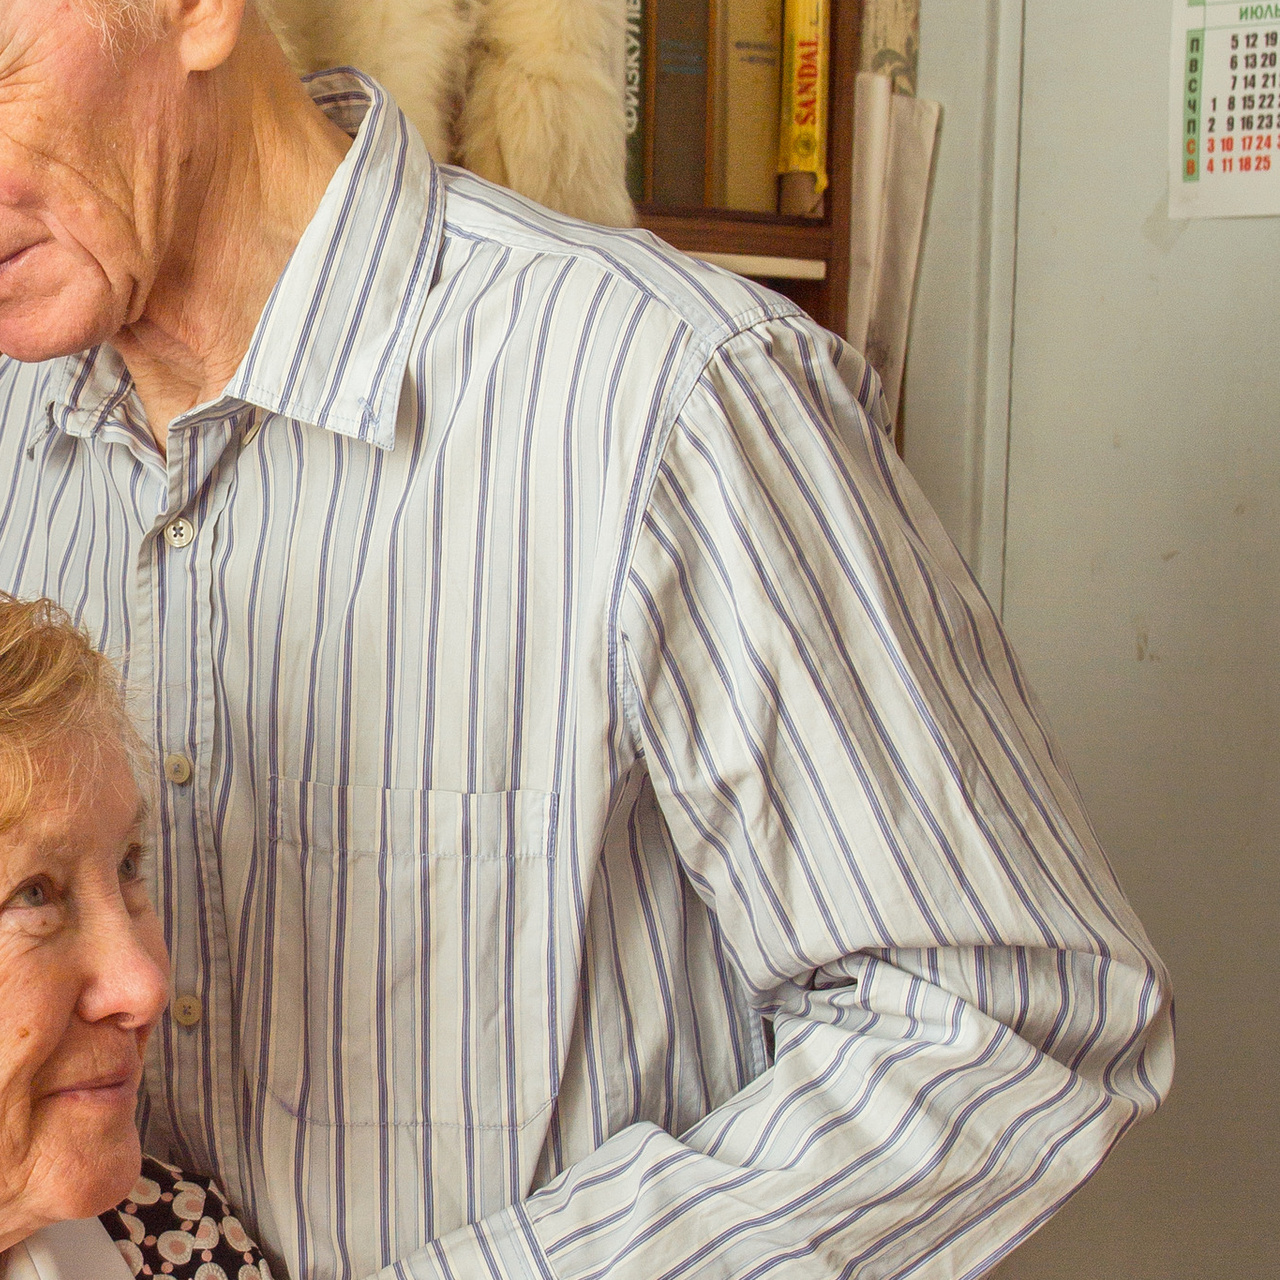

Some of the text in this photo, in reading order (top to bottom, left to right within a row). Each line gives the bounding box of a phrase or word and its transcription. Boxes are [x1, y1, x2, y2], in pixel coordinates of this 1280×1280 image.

[1190, 31, 1278, 53] П 5 12 19
[1230, 54, 1238, 70] 6
[1244, 53, 1257, 69] 13
[1261, 51, 1277, 68] 20
[793, 33, 819, 127] SANDAL
[1188, 73, 1276, 93] С 7 14 21
[1188, 93, 1274, 114] Ч 1 8 15 22
[1187, 114, 1273, 135] П 2 9 16 23
[1186, 135, 1271, 154] С 3 10 17 24
[1186, 155, 1271, 176] В 4 11 18 25
